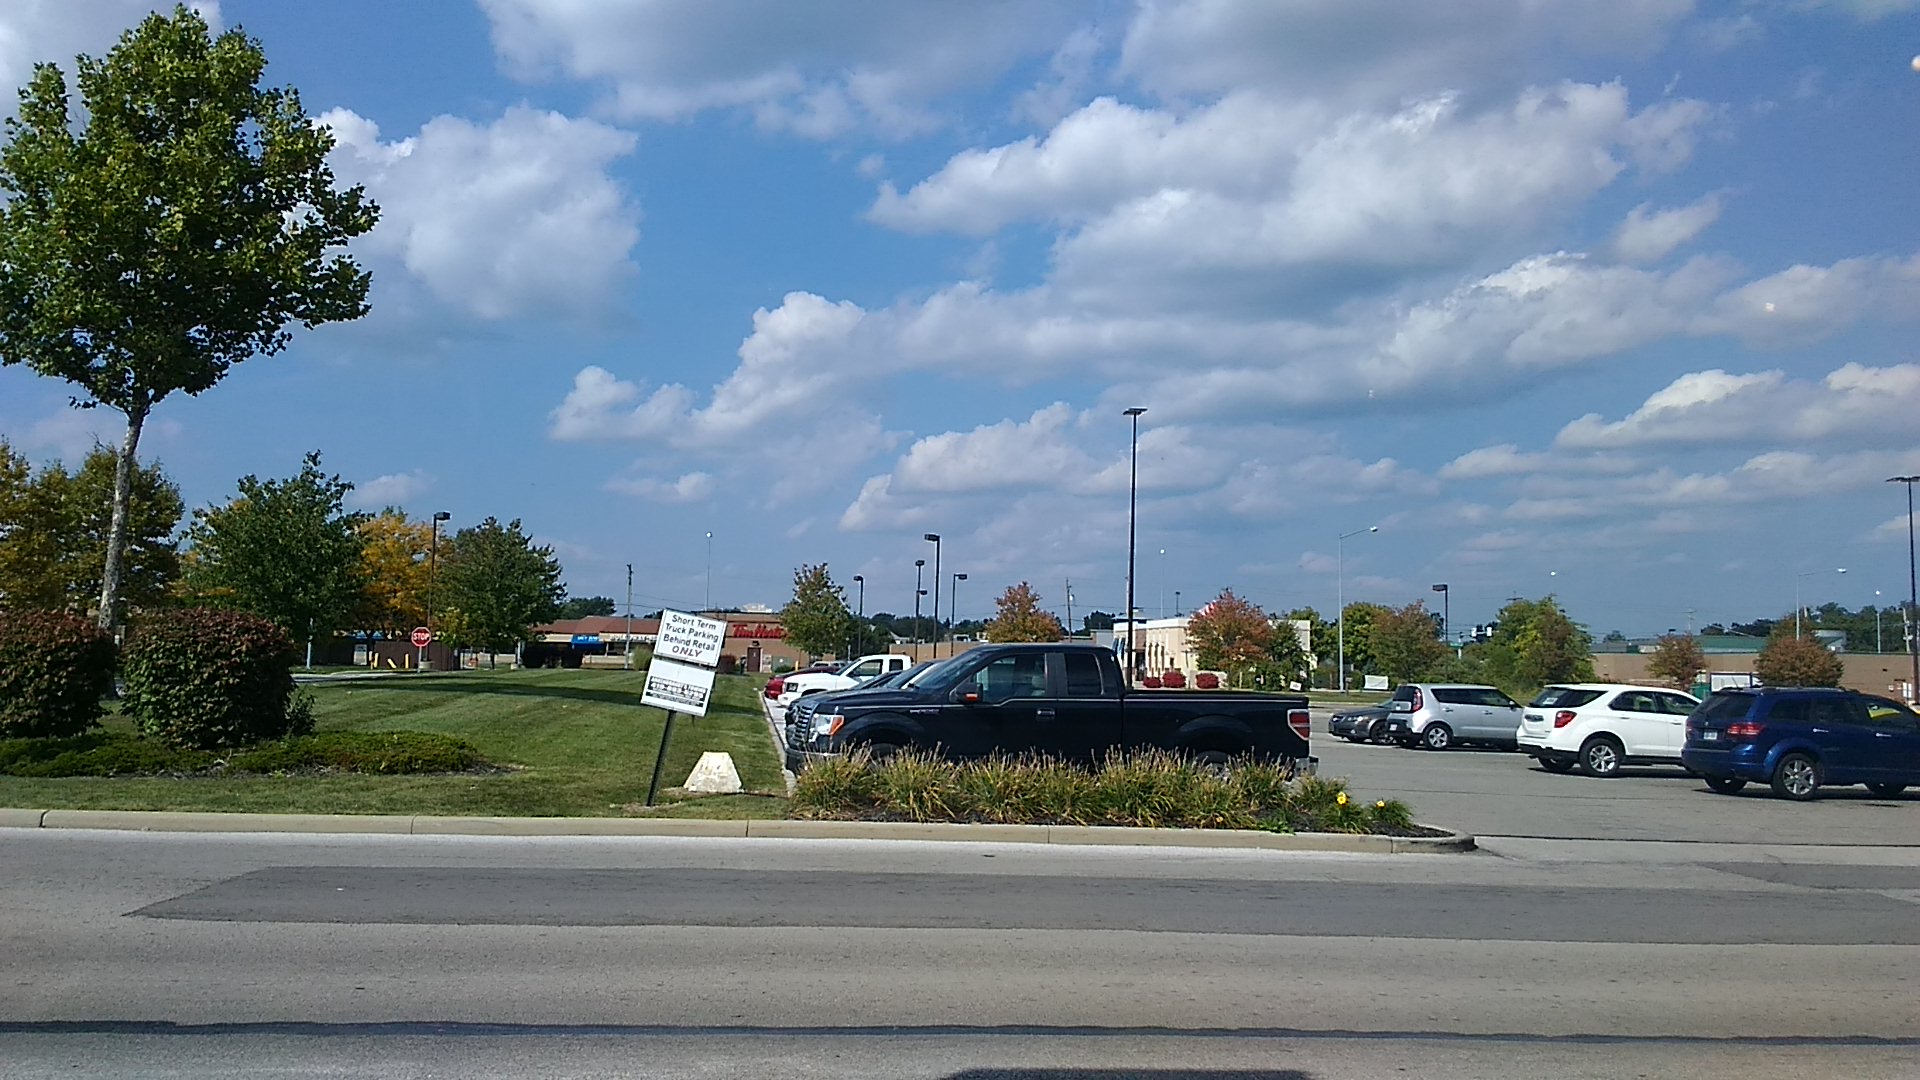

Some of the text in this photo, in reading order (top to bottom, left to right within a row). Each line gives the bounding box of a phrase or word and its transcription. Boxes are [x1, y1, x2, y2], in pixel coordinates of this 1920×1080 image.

[671, 614, 717, 631] Short Term
[413, 632, 430, 640] STOP
[665, 622, 719, 643] Truck Parking
[733, 623, 754, 639] Tim
[663, 633, 691, 646] Behind
[692, 640, 716, 651] Retail
[671, 645, 703, 657] ONLY
